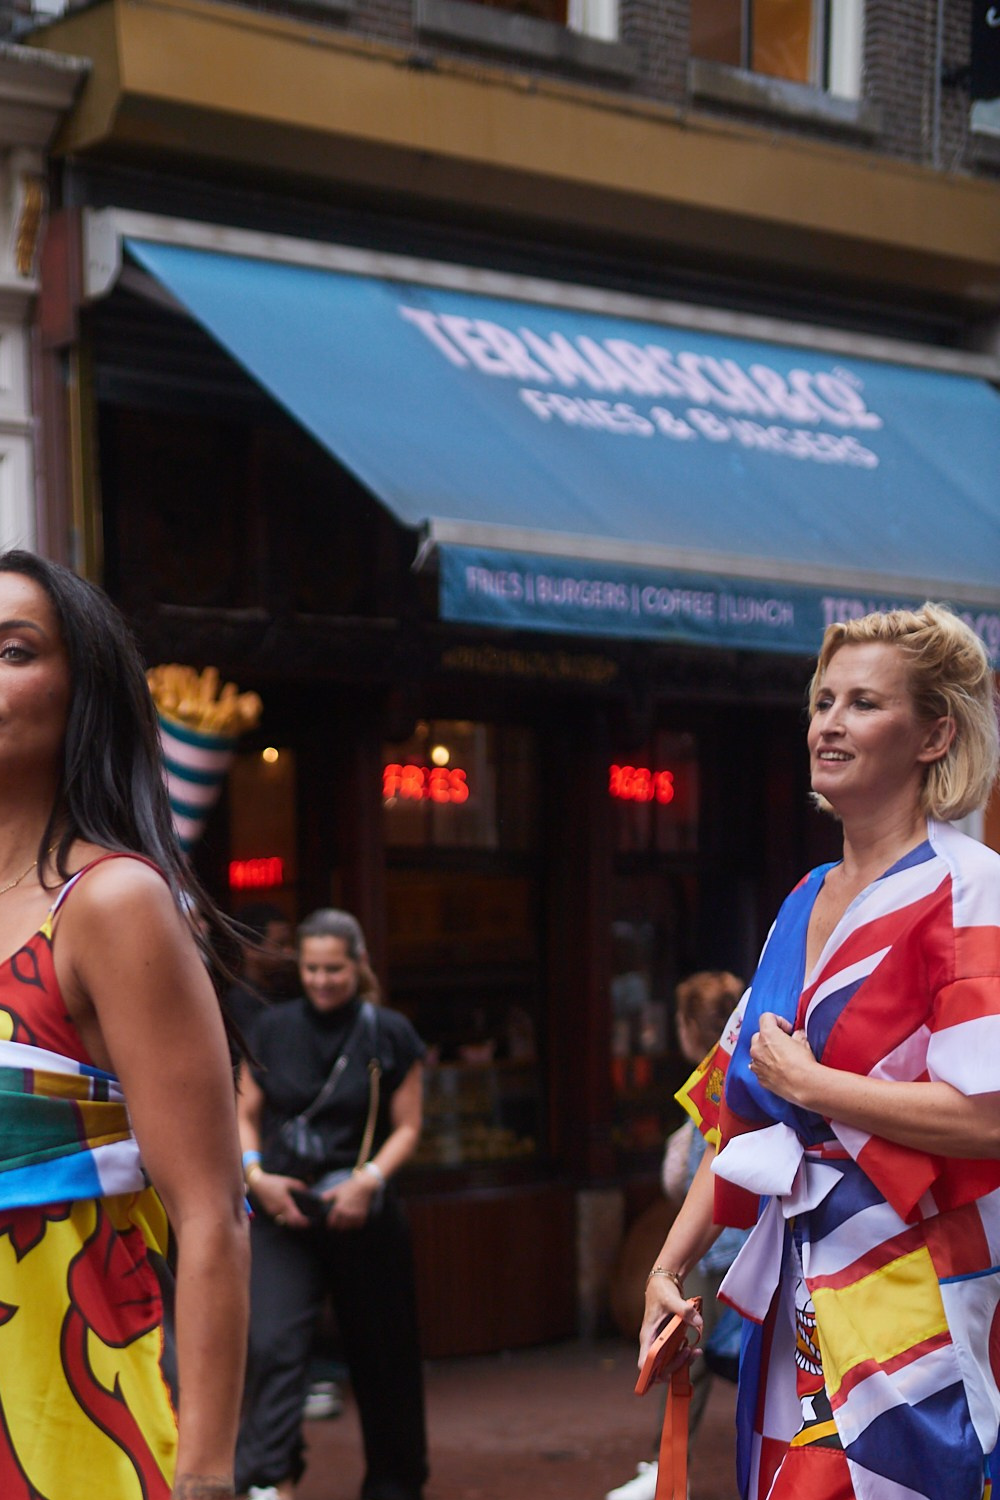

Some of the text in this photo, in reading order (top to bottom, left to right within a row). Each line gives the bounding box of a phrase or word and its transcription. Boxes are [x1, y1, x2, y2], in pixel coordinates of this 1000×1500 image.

[519, 387, 655, 437] FRIES
[650, 405, 697, 440] &
[466, 565, 523, 600] FRIES
[536, 574, 630, 611] BURGERS
[641, 585, 716, 619] COFFEE
[729, 594, 795, 628] LUNCH
